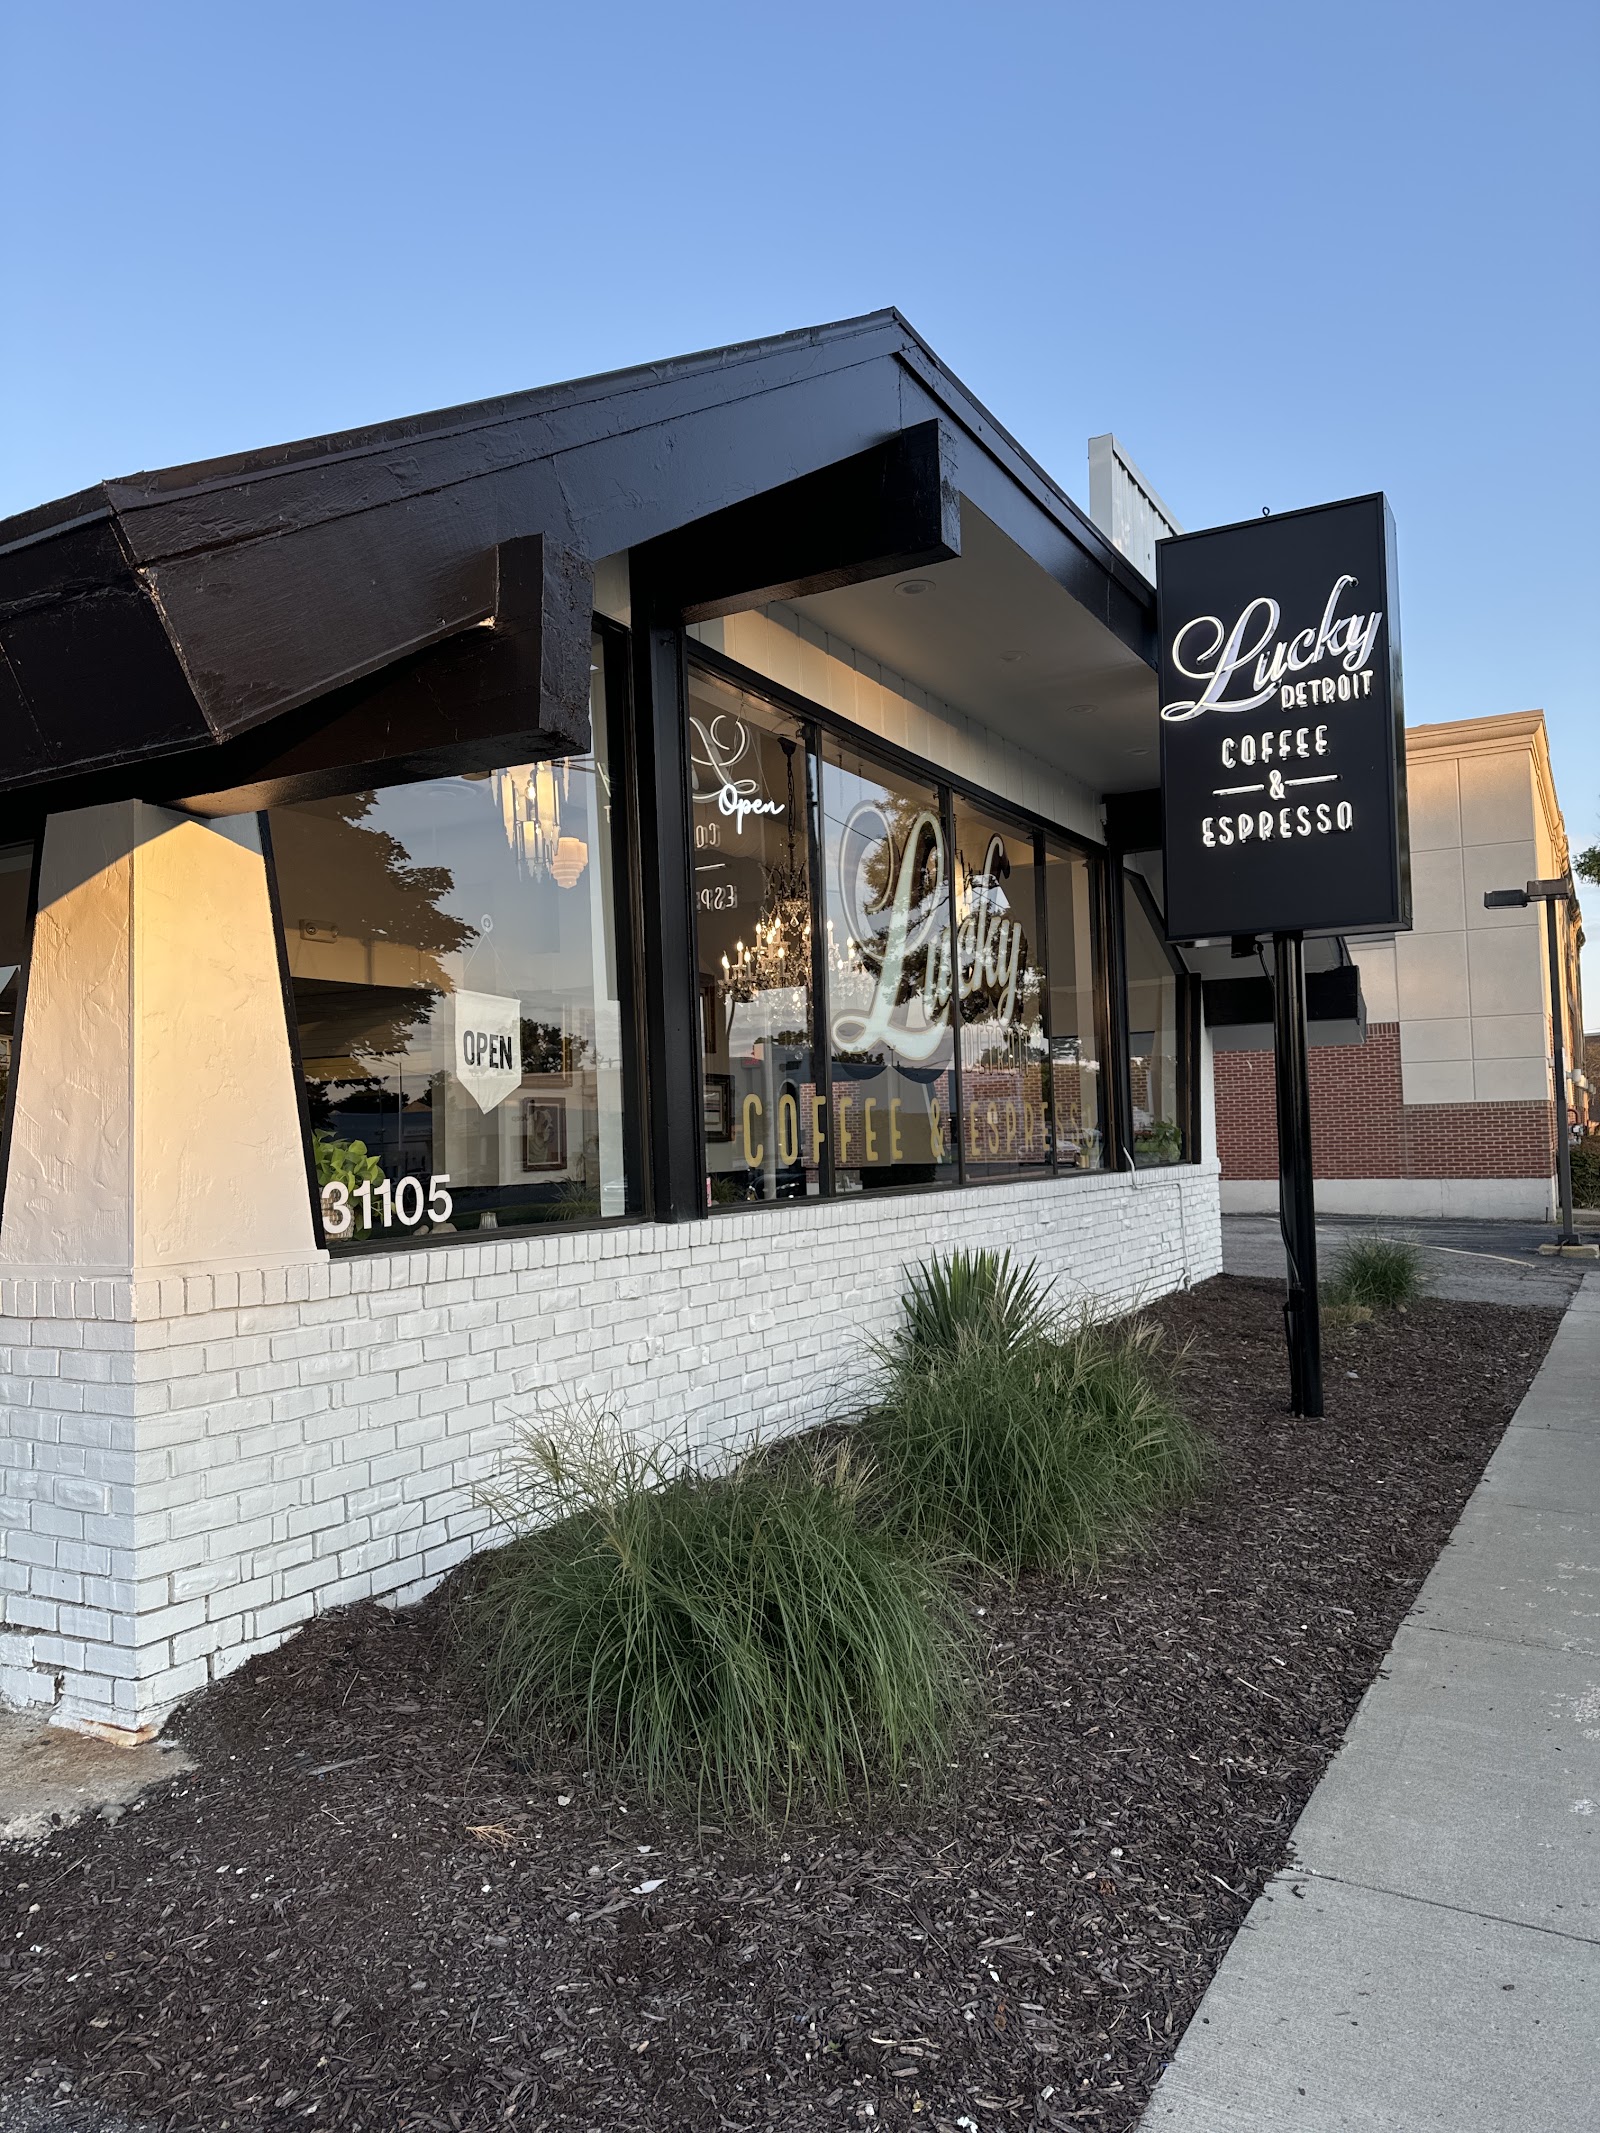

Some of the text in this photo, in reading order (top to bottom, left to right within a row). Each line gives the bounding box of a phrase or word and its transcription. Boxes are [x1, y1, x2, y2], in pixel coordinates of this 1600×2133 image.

[1160, 574, 1383, 722] Lucky
[1281, 669, 1374, 712] DETROIT
[1221, 724, 1330, 769] COFFEE
[719, 783, 786, 835] Open
[1269, 769, 1286, 800] &
[1202, 801, 1353, 848] ESPRESSO
[831, 804, 1023, 1061] Lucky
[463, 1030, 513, 1070] OPEN
[742, 1093, 904, 1168] COFFEE
[930, 1097, 947, 1158] &
[321, 1174, 453, 1234] 31105
